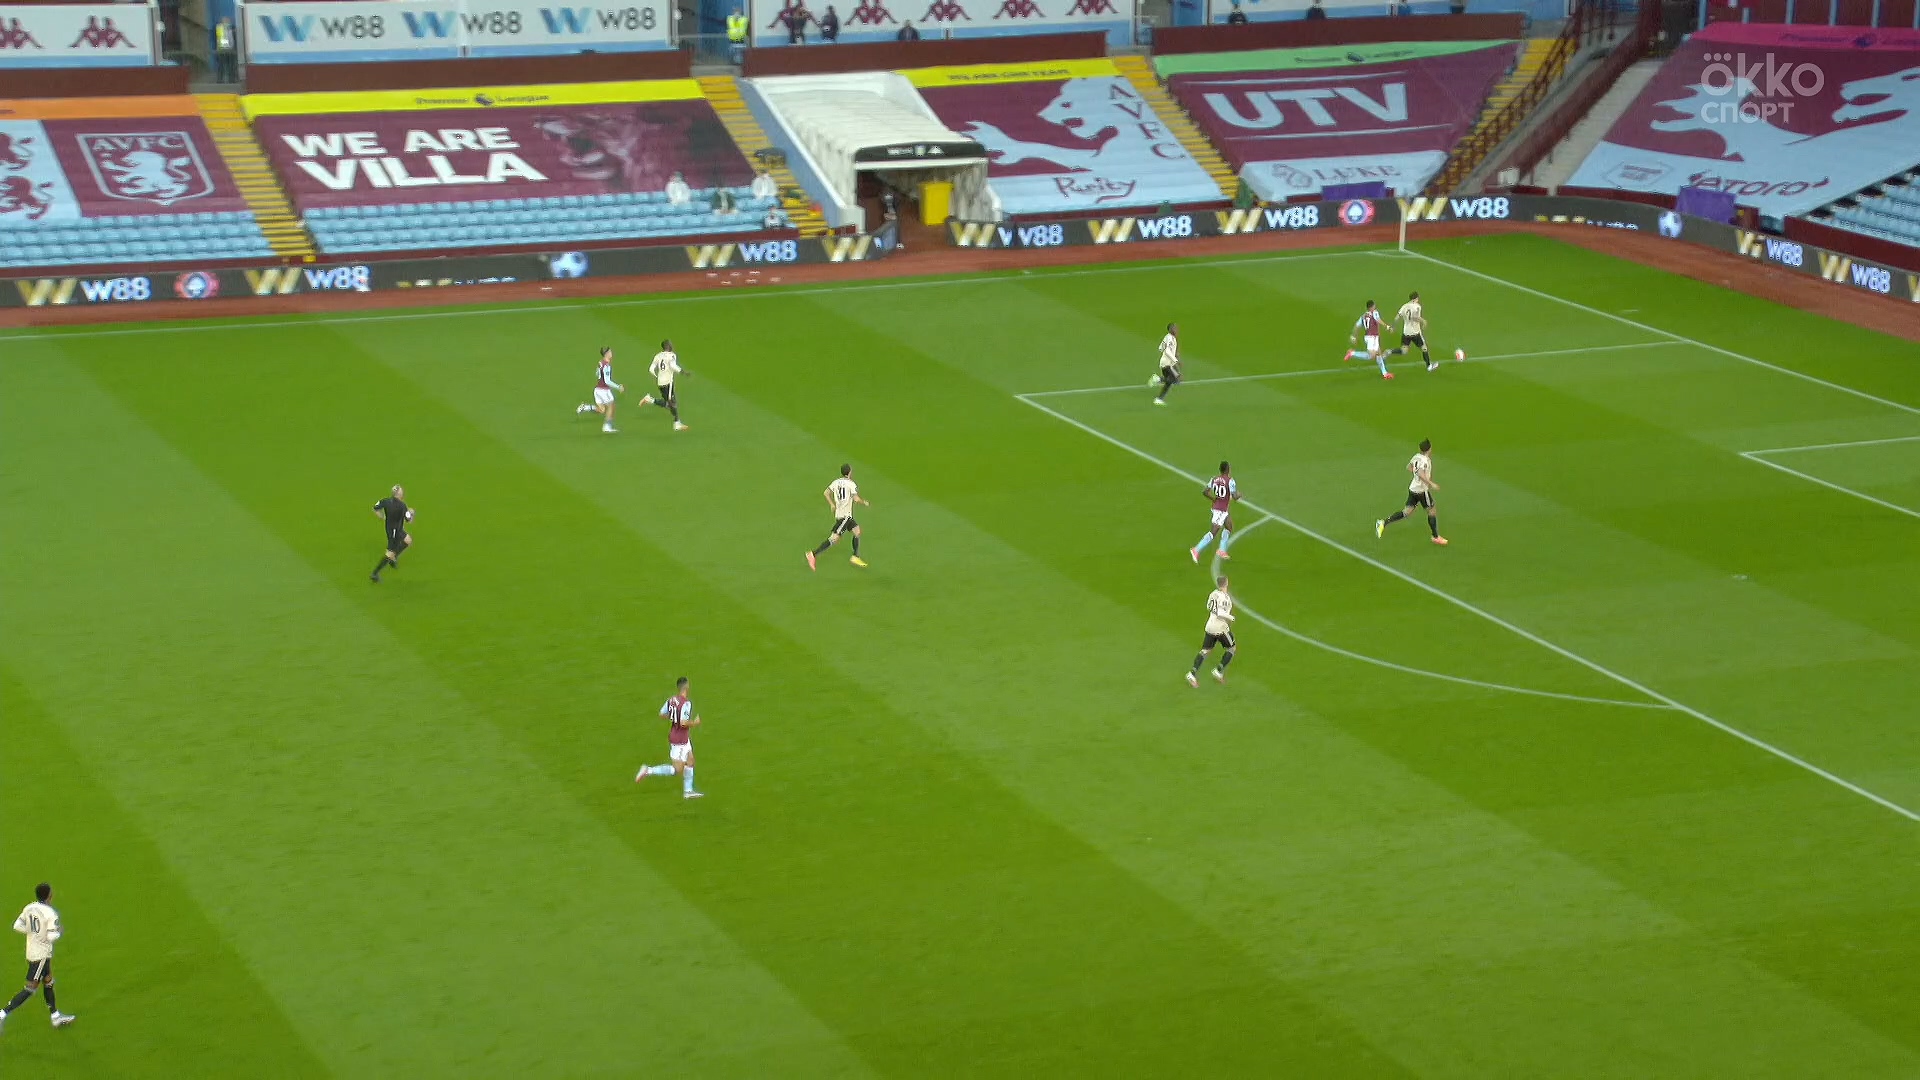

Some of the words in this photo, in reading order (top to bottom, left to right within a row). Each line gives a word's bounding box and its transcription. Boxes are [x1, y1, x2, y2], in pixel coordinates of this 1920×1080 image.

[320, 15, 385, 38] W88
[460, 11, 522, 34] W88
[596, 7, 656, 30] W88
[1203, 82, 1409, 129] UTV
[92, 136, 185, 151] AVFC
[281, 131, 388, 157] WE
[403, 127, 520, 152] ARE
[294, 152, 549, 190] VILLA
[1264, 205, 1319, 229] W88
[1450, 197, 1510, 219] W88
[1137, 215, 1192, 239] W88
[738, 239, 798, 262] W88
[1765, 238, 1803, 267] W88
[80, 276, 151, 302] W88
[304, 265, 371, 291] W88
[1851, 262, 1891, 294] W88
[29, 913, 41, 933] 10
